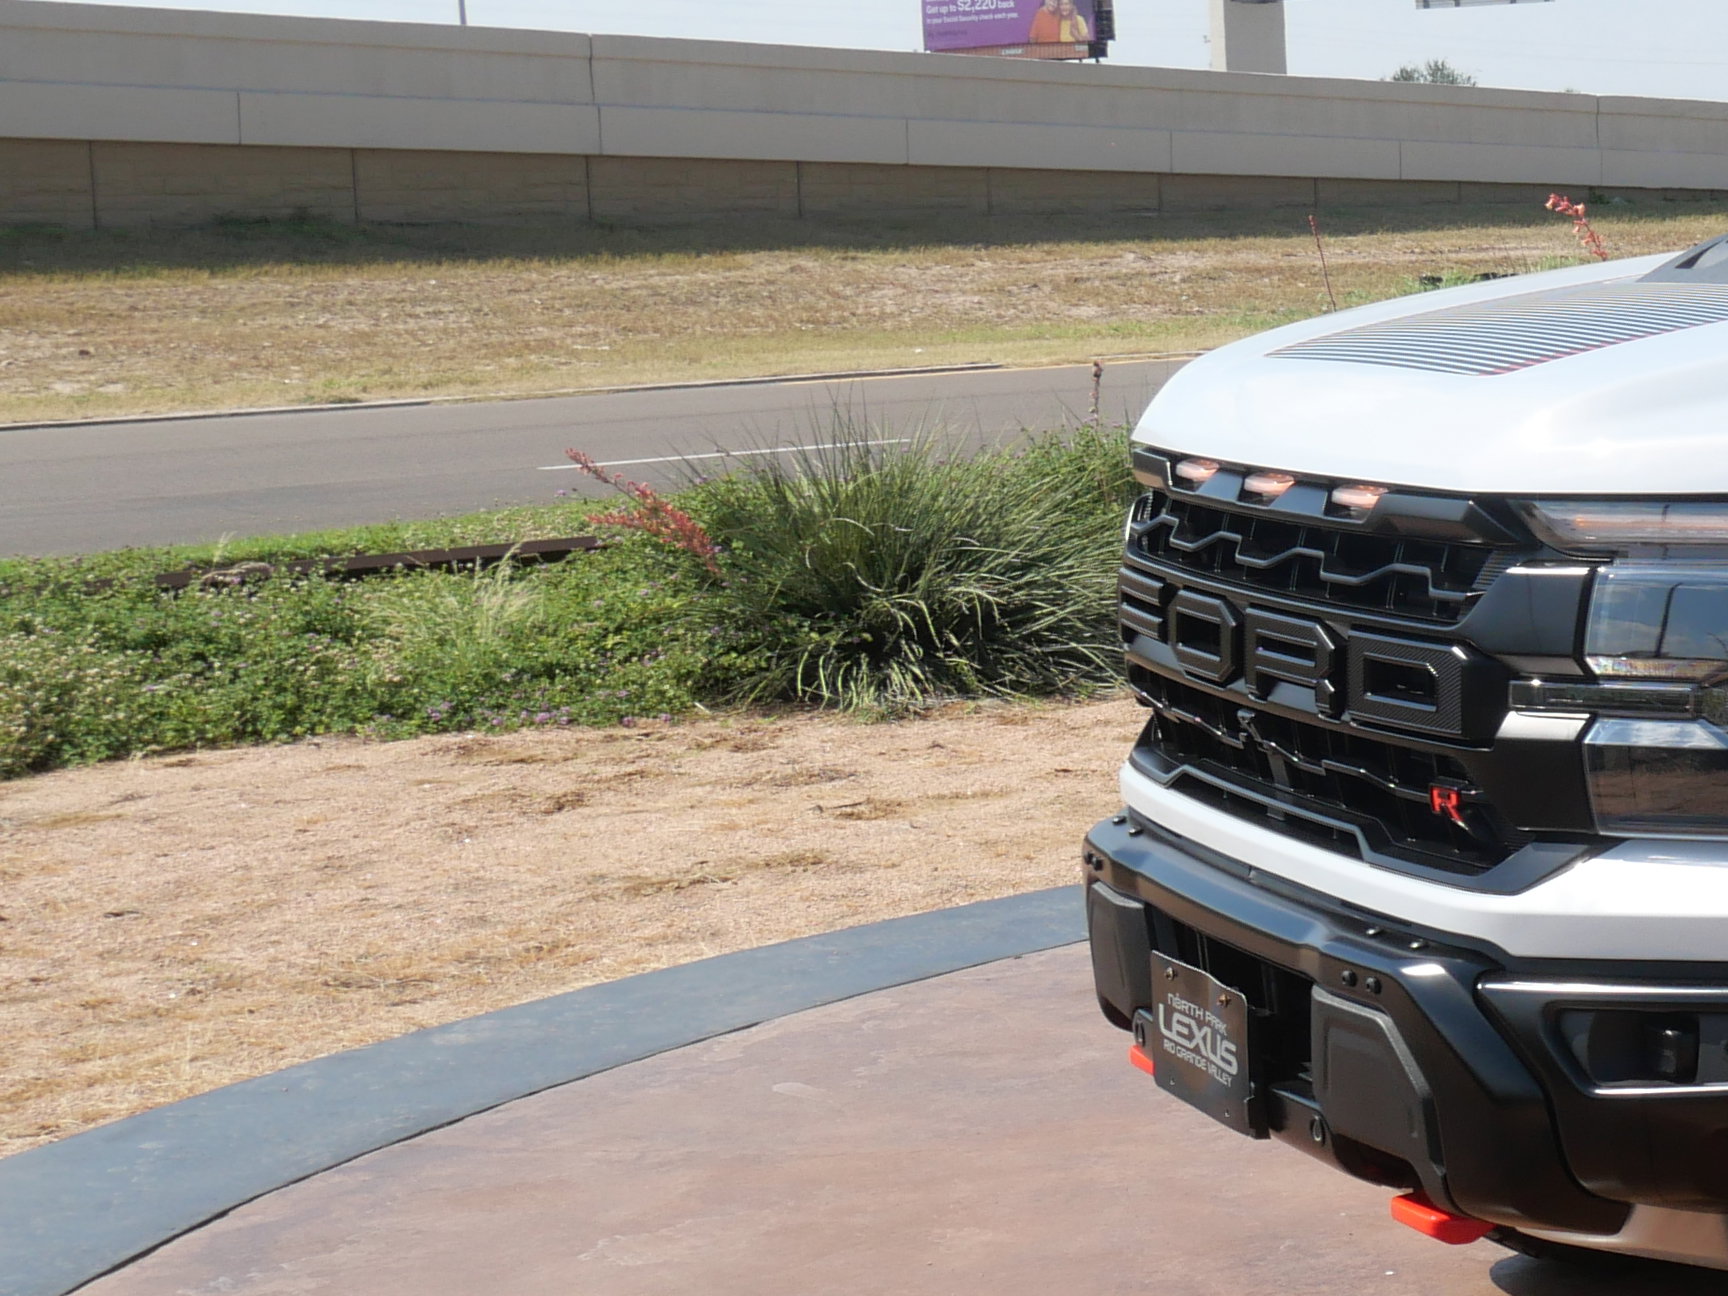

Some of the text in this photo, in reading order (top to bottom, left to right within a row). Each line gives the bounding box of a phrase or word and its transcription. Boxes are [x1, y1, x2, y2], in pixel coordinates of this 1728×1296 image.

[1119, 566, 1476, 736] FORD
[1430, 785, 1468, 831] R
[1158, 1003, 1239, 1075] LEXUS
[1163, 1038, 1176, 1055] RIO
[1207, 1061, 1233, 1087] VALLEY
